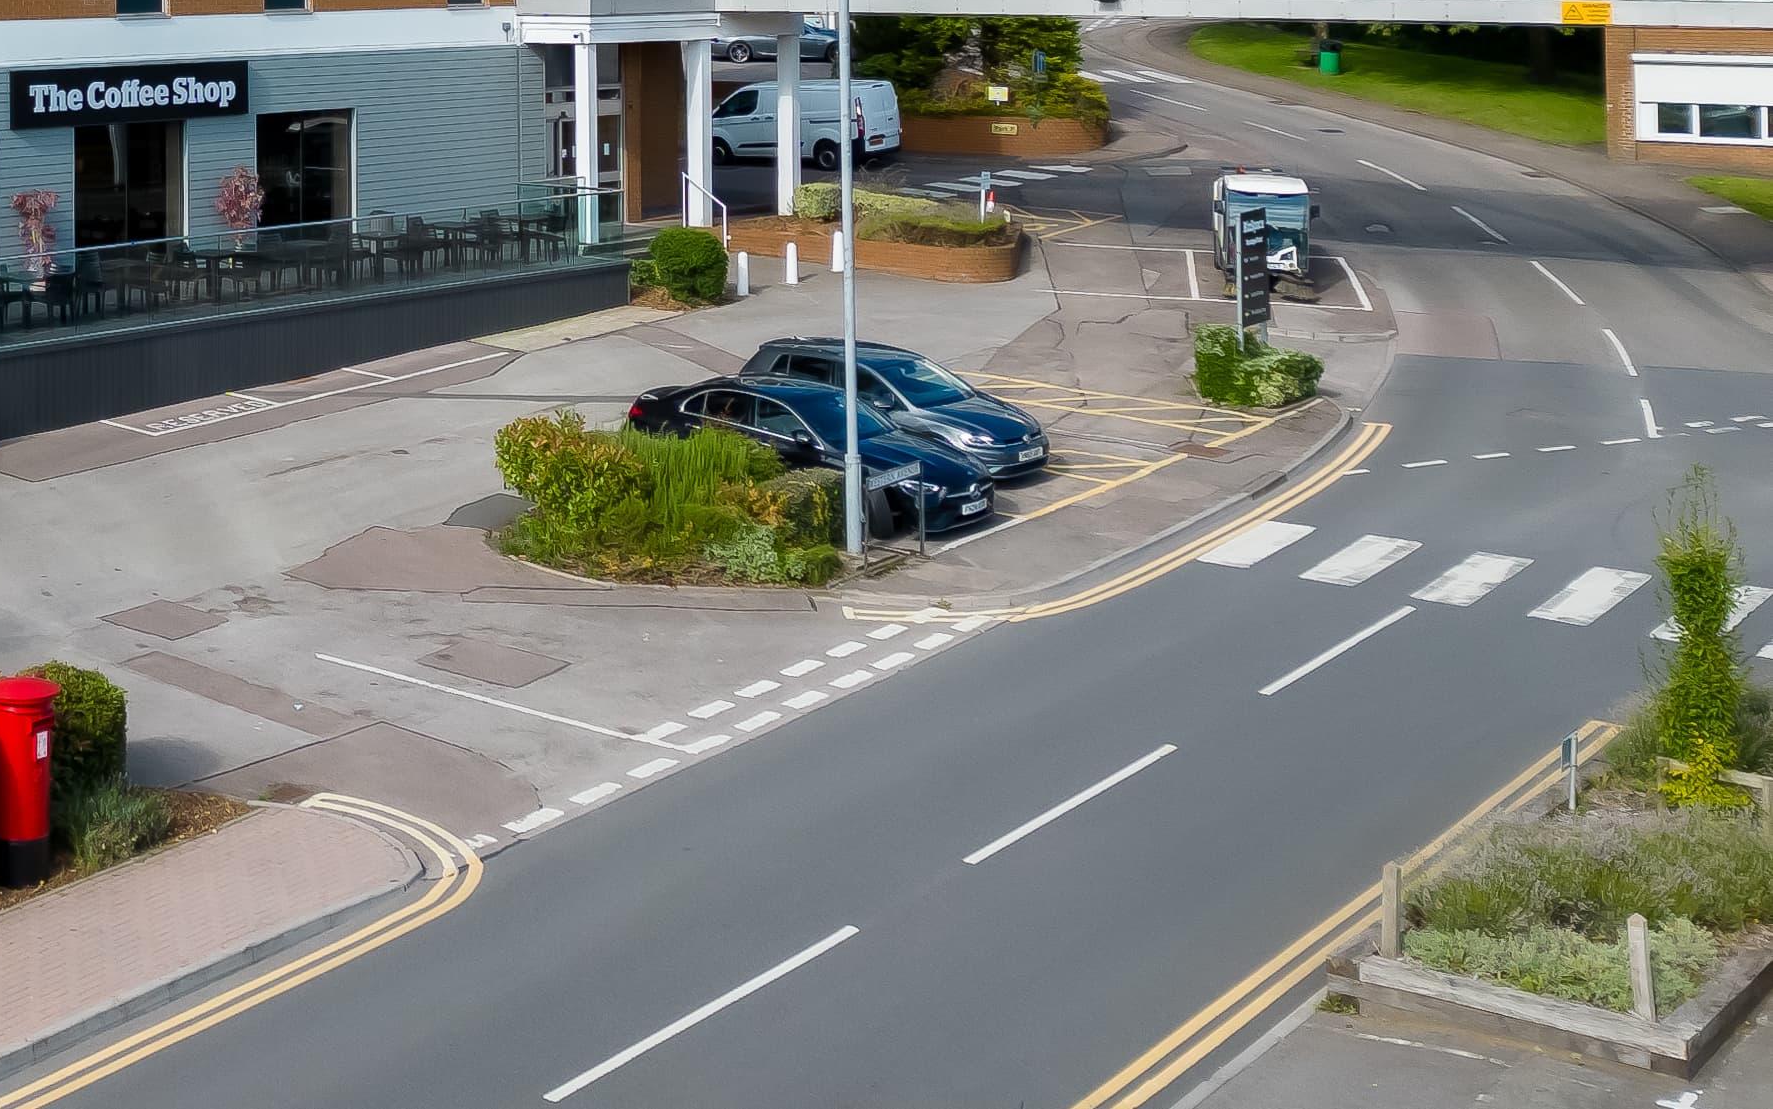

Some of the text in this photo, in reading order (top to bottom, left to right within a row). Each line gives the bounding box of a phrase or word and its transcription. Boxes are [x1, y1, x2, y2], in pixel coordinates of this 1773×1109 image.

[29, 77, 236, 112] The Coffee Shop
